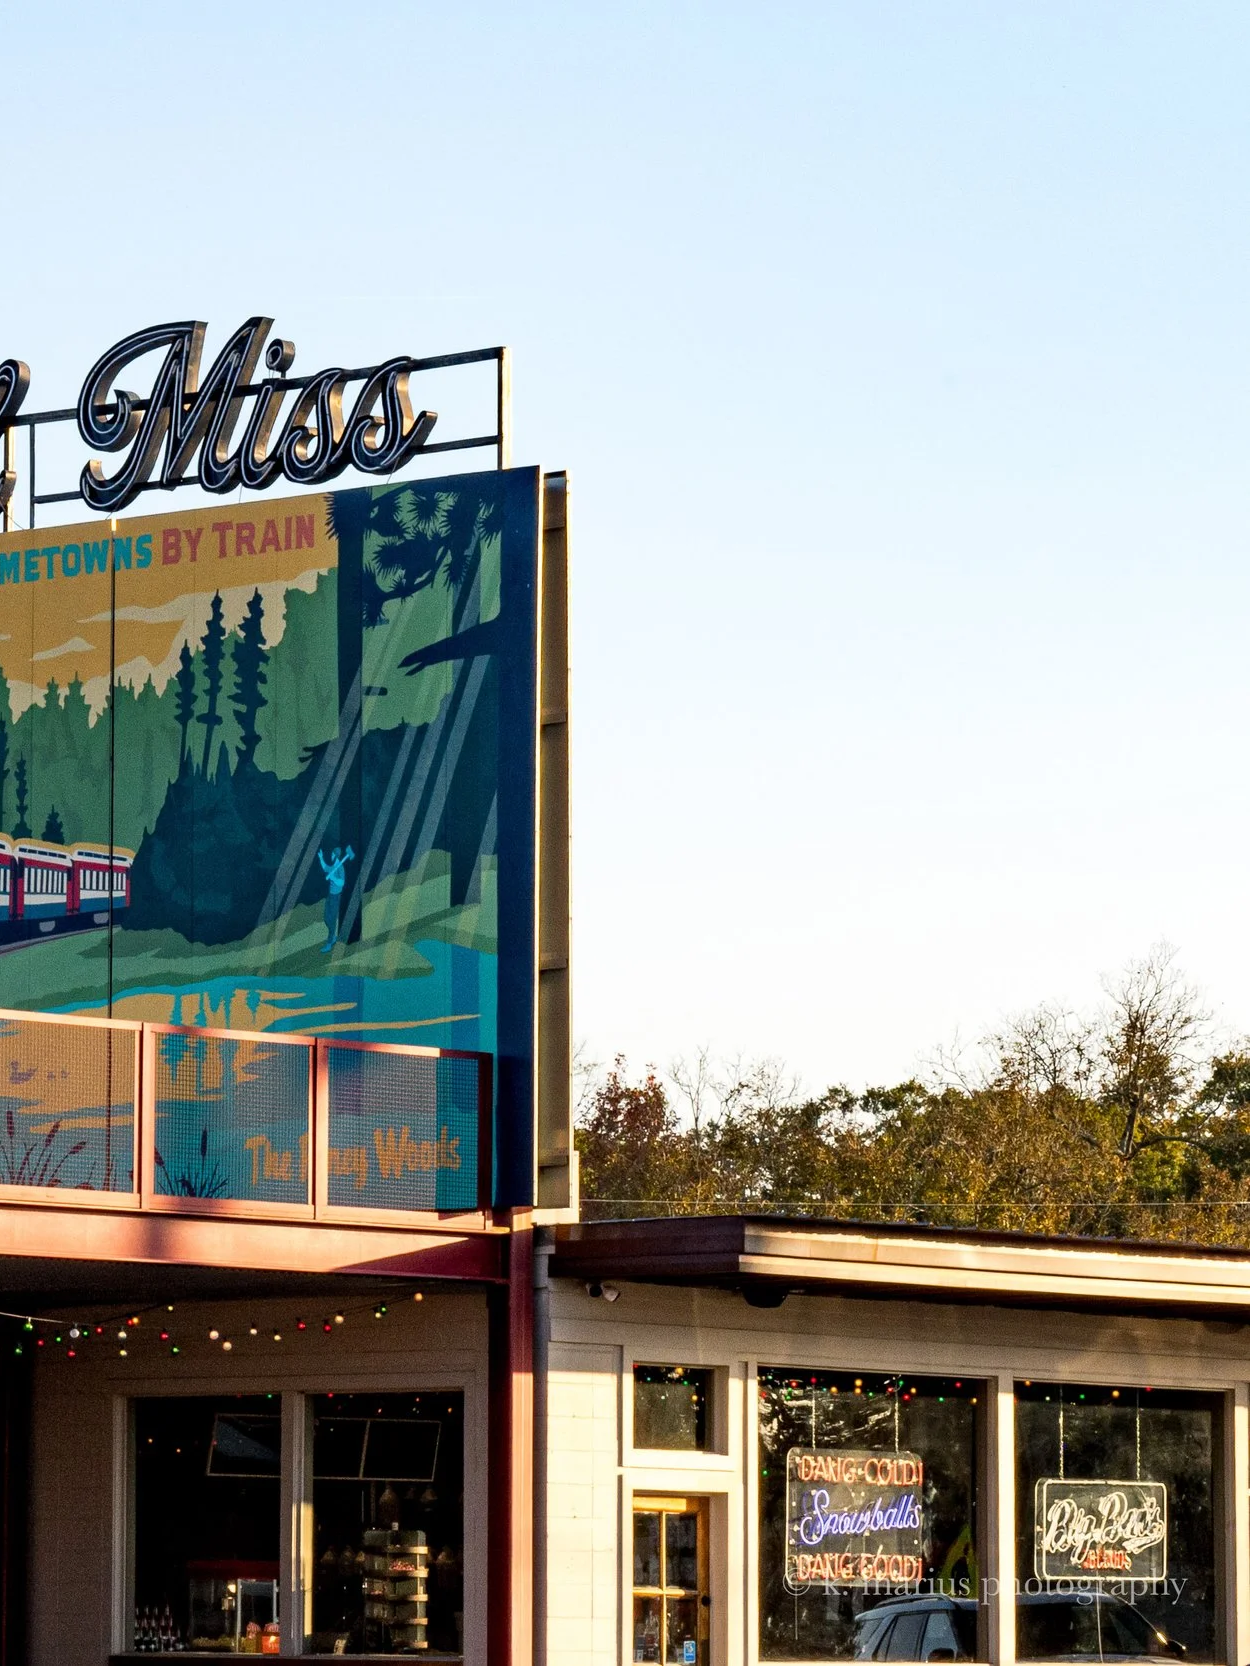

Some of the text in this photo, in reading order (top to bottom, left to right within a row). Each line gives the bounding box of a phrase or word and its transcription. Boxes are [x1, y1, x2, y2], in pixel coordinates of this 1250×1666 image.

[78, 316, 438, 512] Miss
[161, 527, 205, 566] BY
[212, 513, 315, 559] TRAIN
[244, 1134, 292, 1186] The
[799, 1454, 856, 1484] DANG
[800, 1490, 922, 1545] Snowballs
